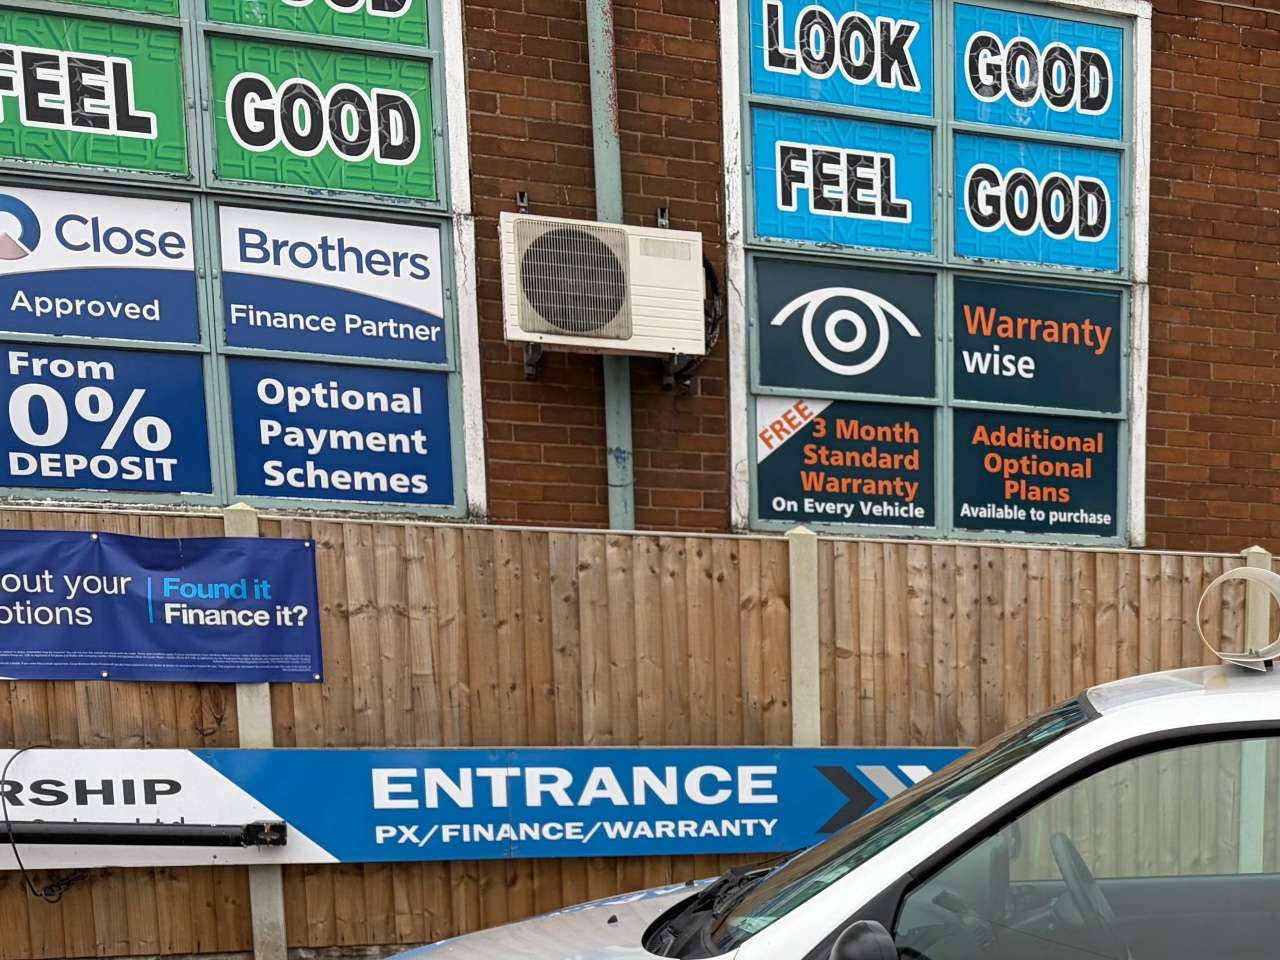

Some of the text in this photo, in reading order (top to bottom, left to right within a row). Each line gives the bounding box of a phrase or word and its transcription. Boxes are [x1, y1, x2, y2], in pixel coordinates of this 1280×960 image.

[763, 0, 921, 92] LOOK
[964, 31, 1113, 115] GOOD
[226, 72, 421, 165] GOOD
[775, 140, 912, 224] FEEL
[964, 164, 1111, 242] GOOD
[55, 213, 431, 281] Close Brothers
[10, 290, 441, 342] Approved Finance Partner
[963, 304, 1112, 355] Warranty
[8, 350, 115, 380] From
[961, 344, 1036, 379] wise
[256, 377, 423, 415] Optional
[8, 383, 172, 452] 0%
[758, 399, 815, 450] FREE
[811, 417, 920, 444] 3 Month
[259, 419, 428, 456] Payment
[971, 424, 1104, 453] Additional
[8, 451, 178, 482] DEPOSIT
[802, 443, 920, 471] Standard
[983, 452, 1093, 479] Optional
[262, 459, 429, 495] Schemes
[800, 470, 920, 503] Warranty
[1003, 479, 1071, 503] Plans
[771, 496, 925, 519] On Every Vehicle
[959, 503, 1112, 526] Available to purchase
[1, 569, 132, 600] out your
[163, 577, 271, 600] Found it
[164, 603, 309, 627] Finance it?
[371, 765, 779, 810] ENTRANCE
[375, 818, 779, 847] PX/FINANCE/WARRANTY
